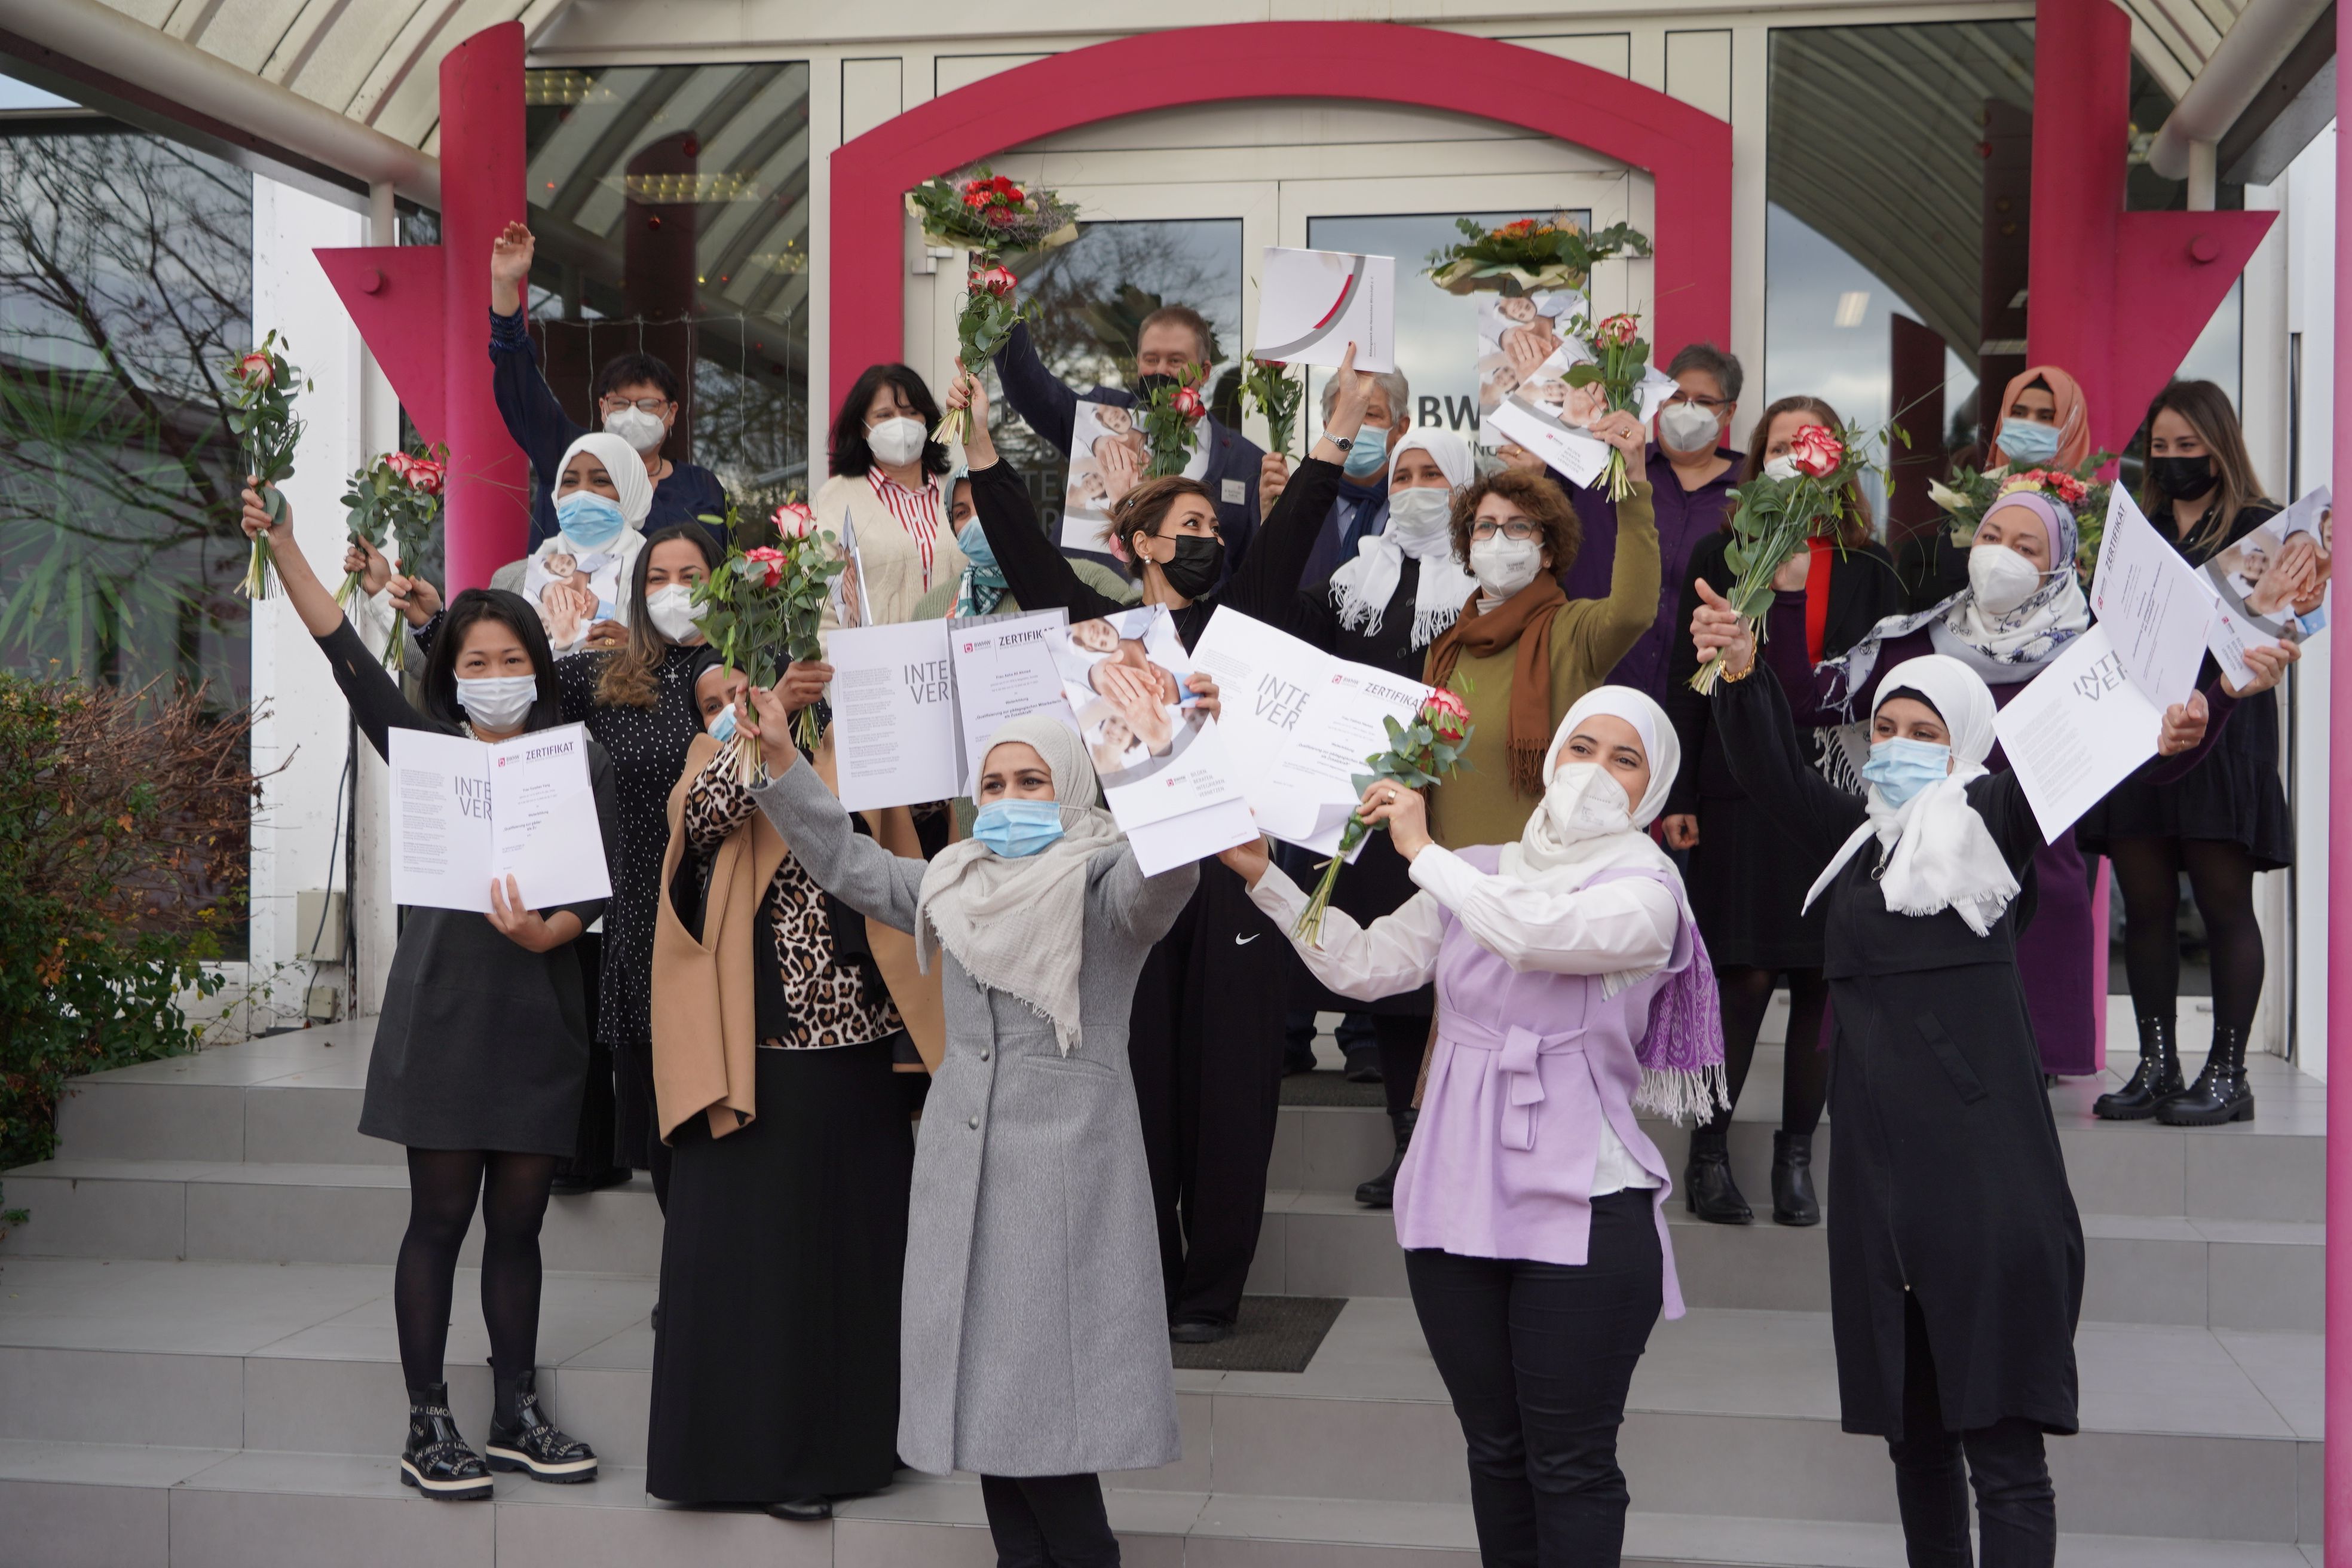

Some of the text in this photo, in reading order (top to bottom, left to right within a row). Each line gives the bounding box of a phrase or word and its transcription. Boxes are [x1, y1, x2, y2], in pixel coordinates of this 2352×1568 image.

[2105, 502, 2126, 571] ZERTIFIKAT
[999, 627, 1055, 647] ZERTIFIK
[1257, 673, 1310, 713] INTE
[1255, 694, 1300, 732] VER
[526, 742, 574, 761] ZERTIFIKAT
[424, 1442, 443, 1454] JELLY
